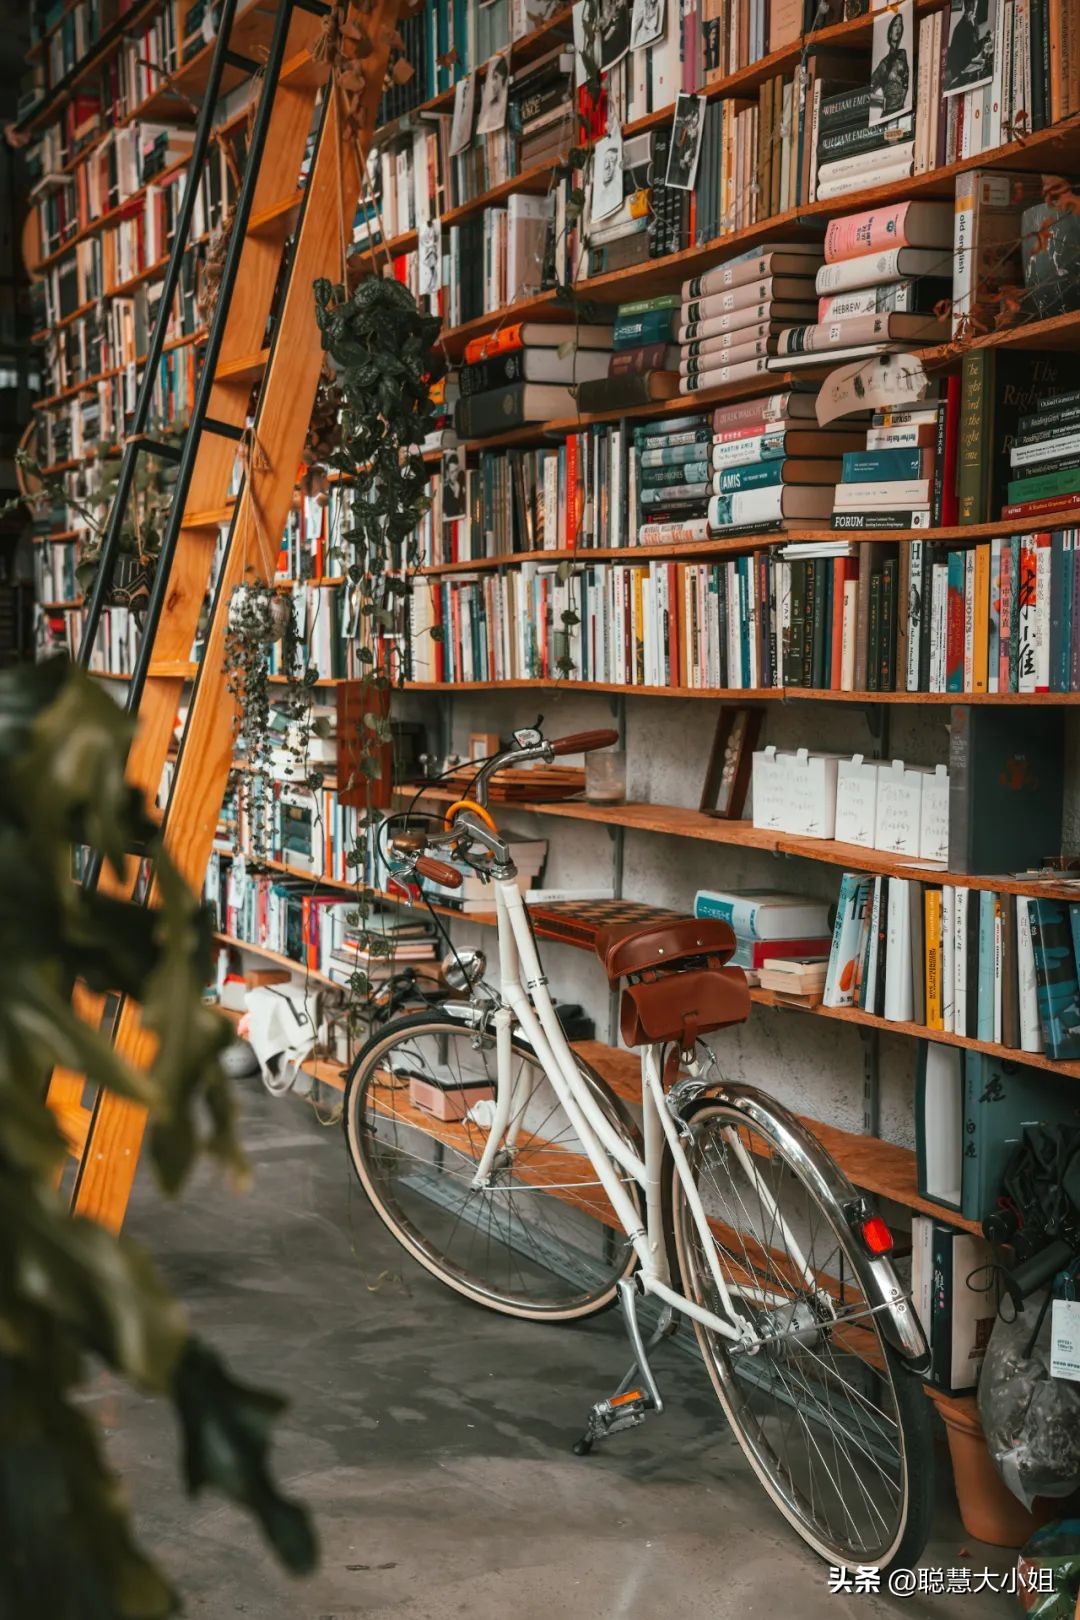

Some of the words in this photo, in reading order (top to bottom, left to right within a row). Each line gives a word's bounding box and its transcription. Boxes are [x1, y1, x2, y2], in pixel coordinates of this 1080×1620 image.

[822, 131, 852, 150] WILLIAM
[832, 301, 862, 316] HEBREW
[722, 473, 741, 489] AMIS
[834, 516, 864, 527] FORUM
[911, 542, 921, 560] H
